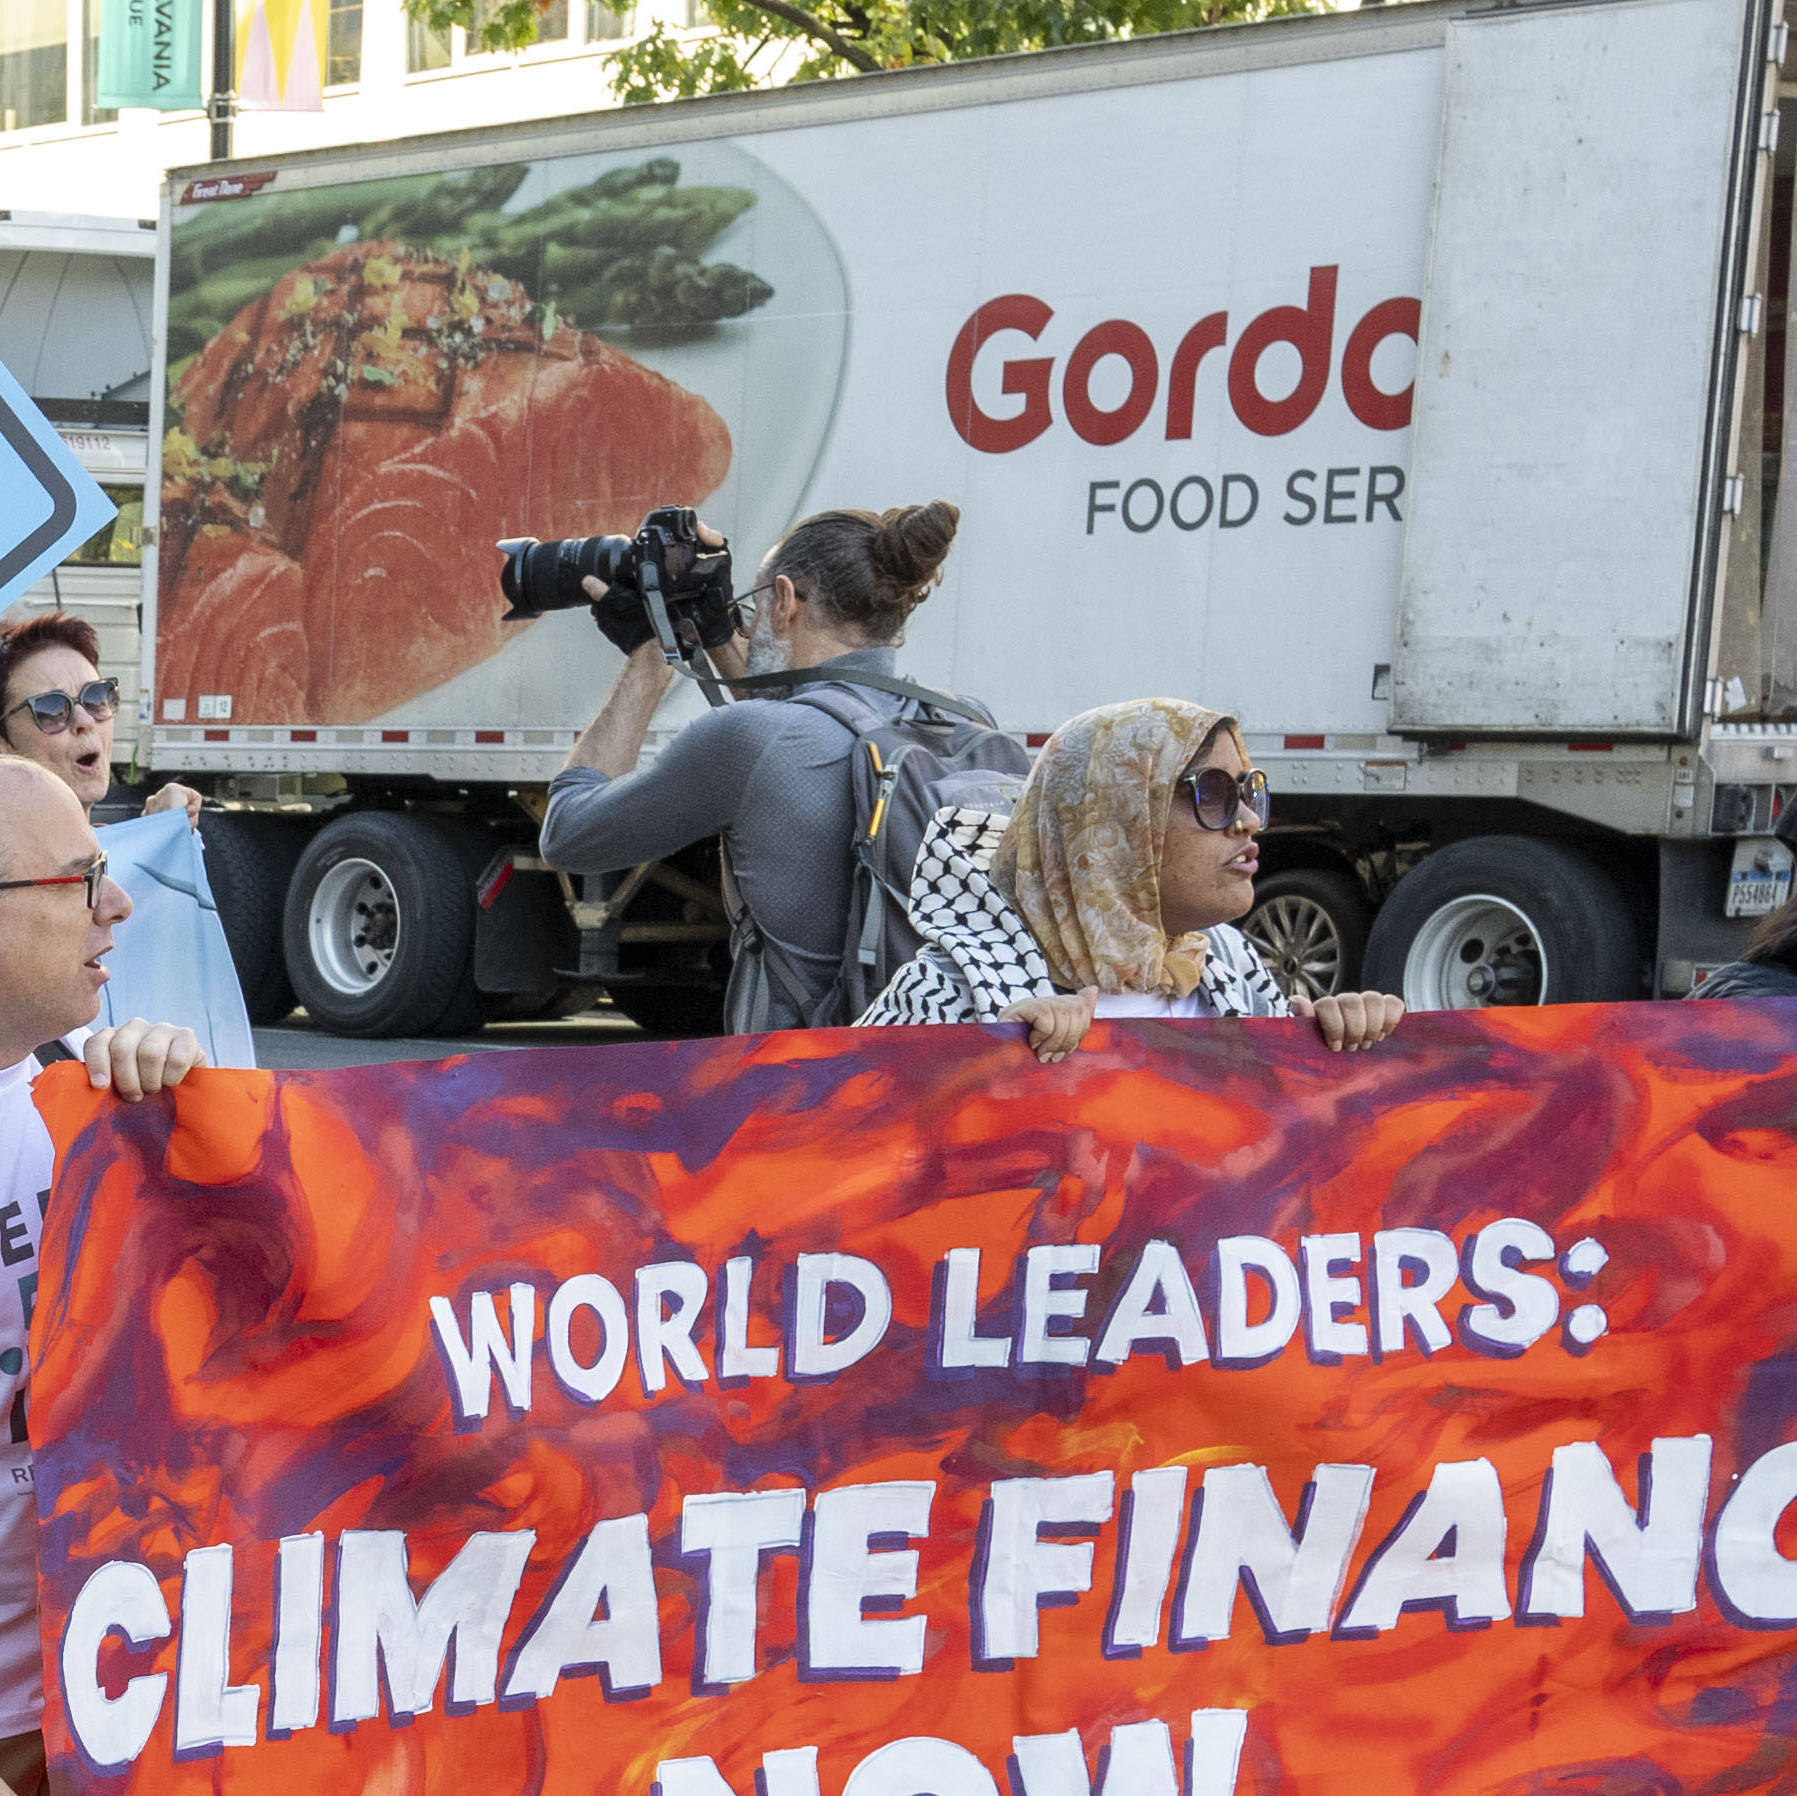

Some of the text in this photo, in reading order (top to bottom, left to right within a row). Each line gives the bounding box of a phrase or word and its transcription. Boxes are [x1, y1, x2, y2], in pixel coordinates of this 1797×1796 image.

[64, 434, 111, 450] 19112
[1086, 465, 1407, 536] FOOD SER
[430, 1217, 1611, 1425] WORLD LEADERS:
[61, 1480, 937, 1771] CLIMATE
